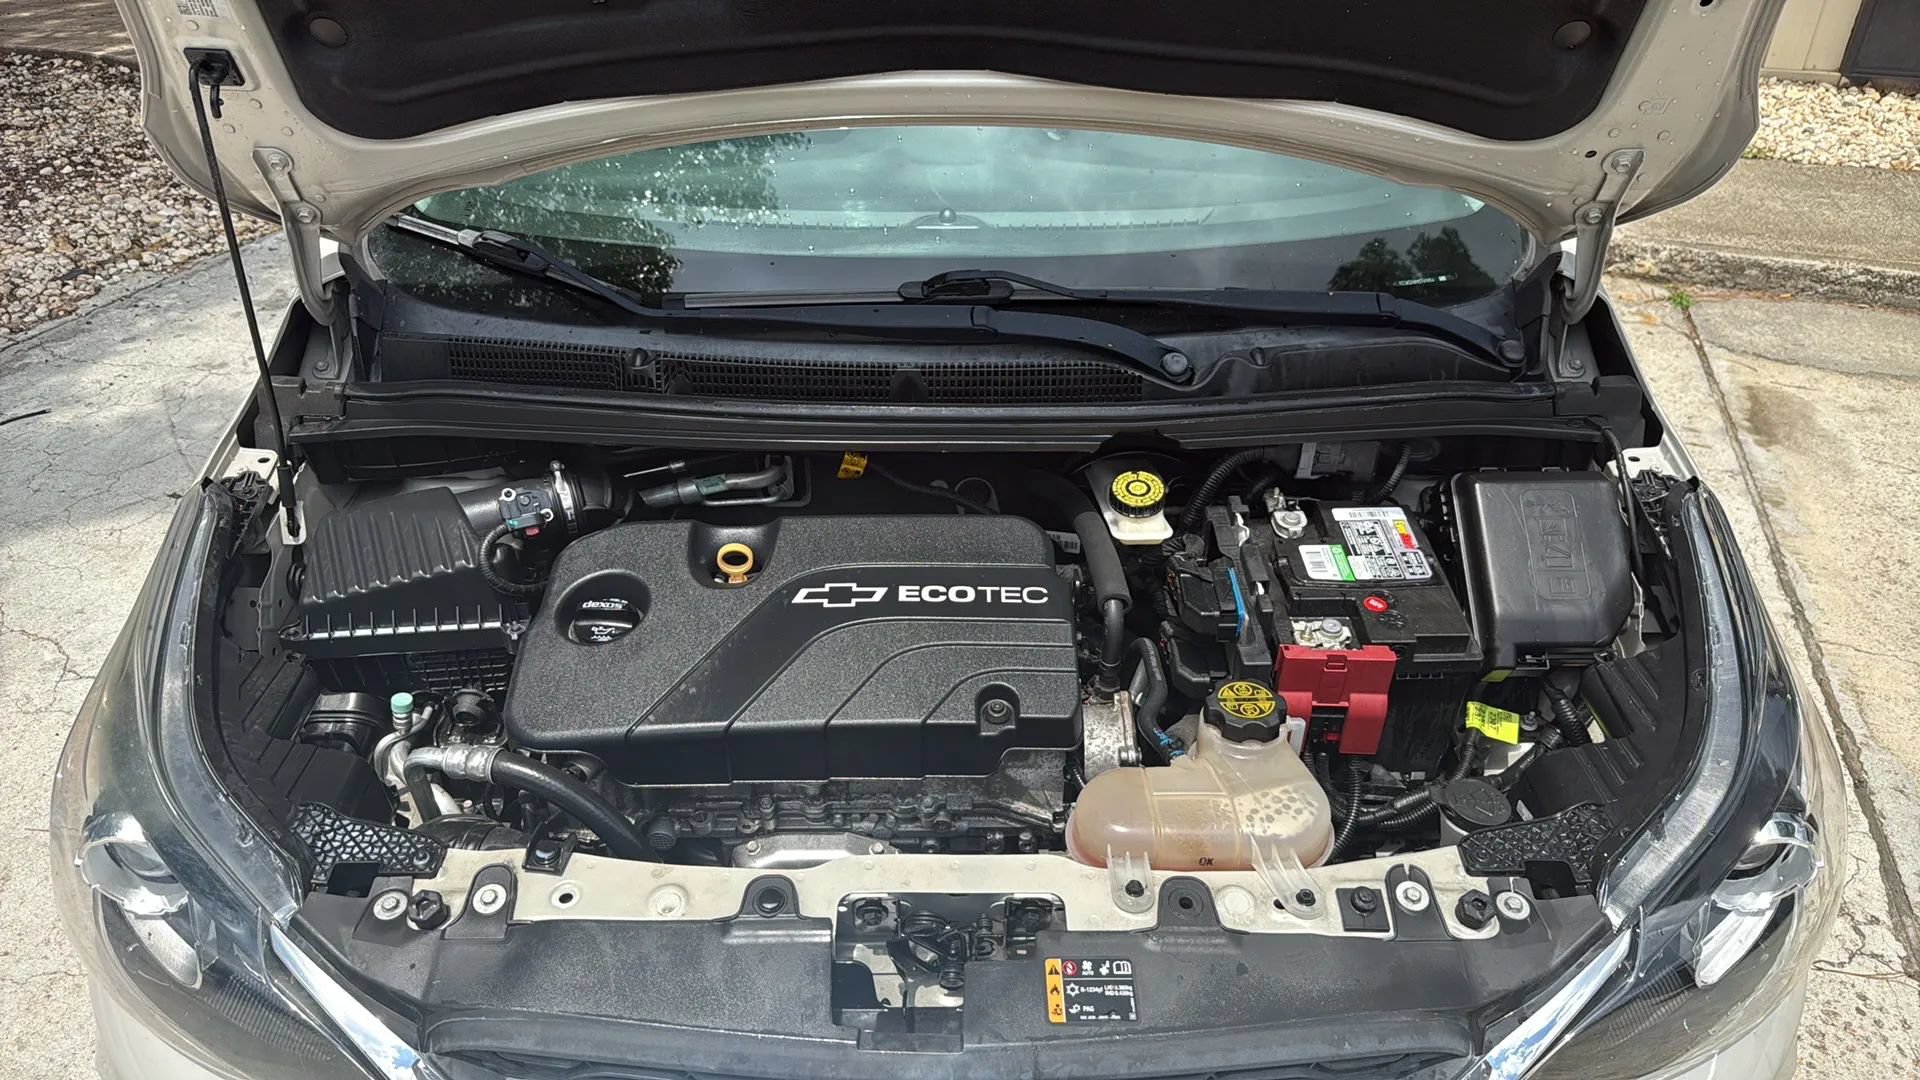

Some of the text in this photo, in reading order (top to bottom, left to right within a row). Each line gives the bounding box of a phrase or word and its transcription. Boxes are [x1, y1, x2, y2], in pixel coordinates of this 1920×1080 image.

[898, 585, 1049, 604] ECOTEC
[582, 600, 623, 609] dexos
[1198, 856, 1214, 866] OK
